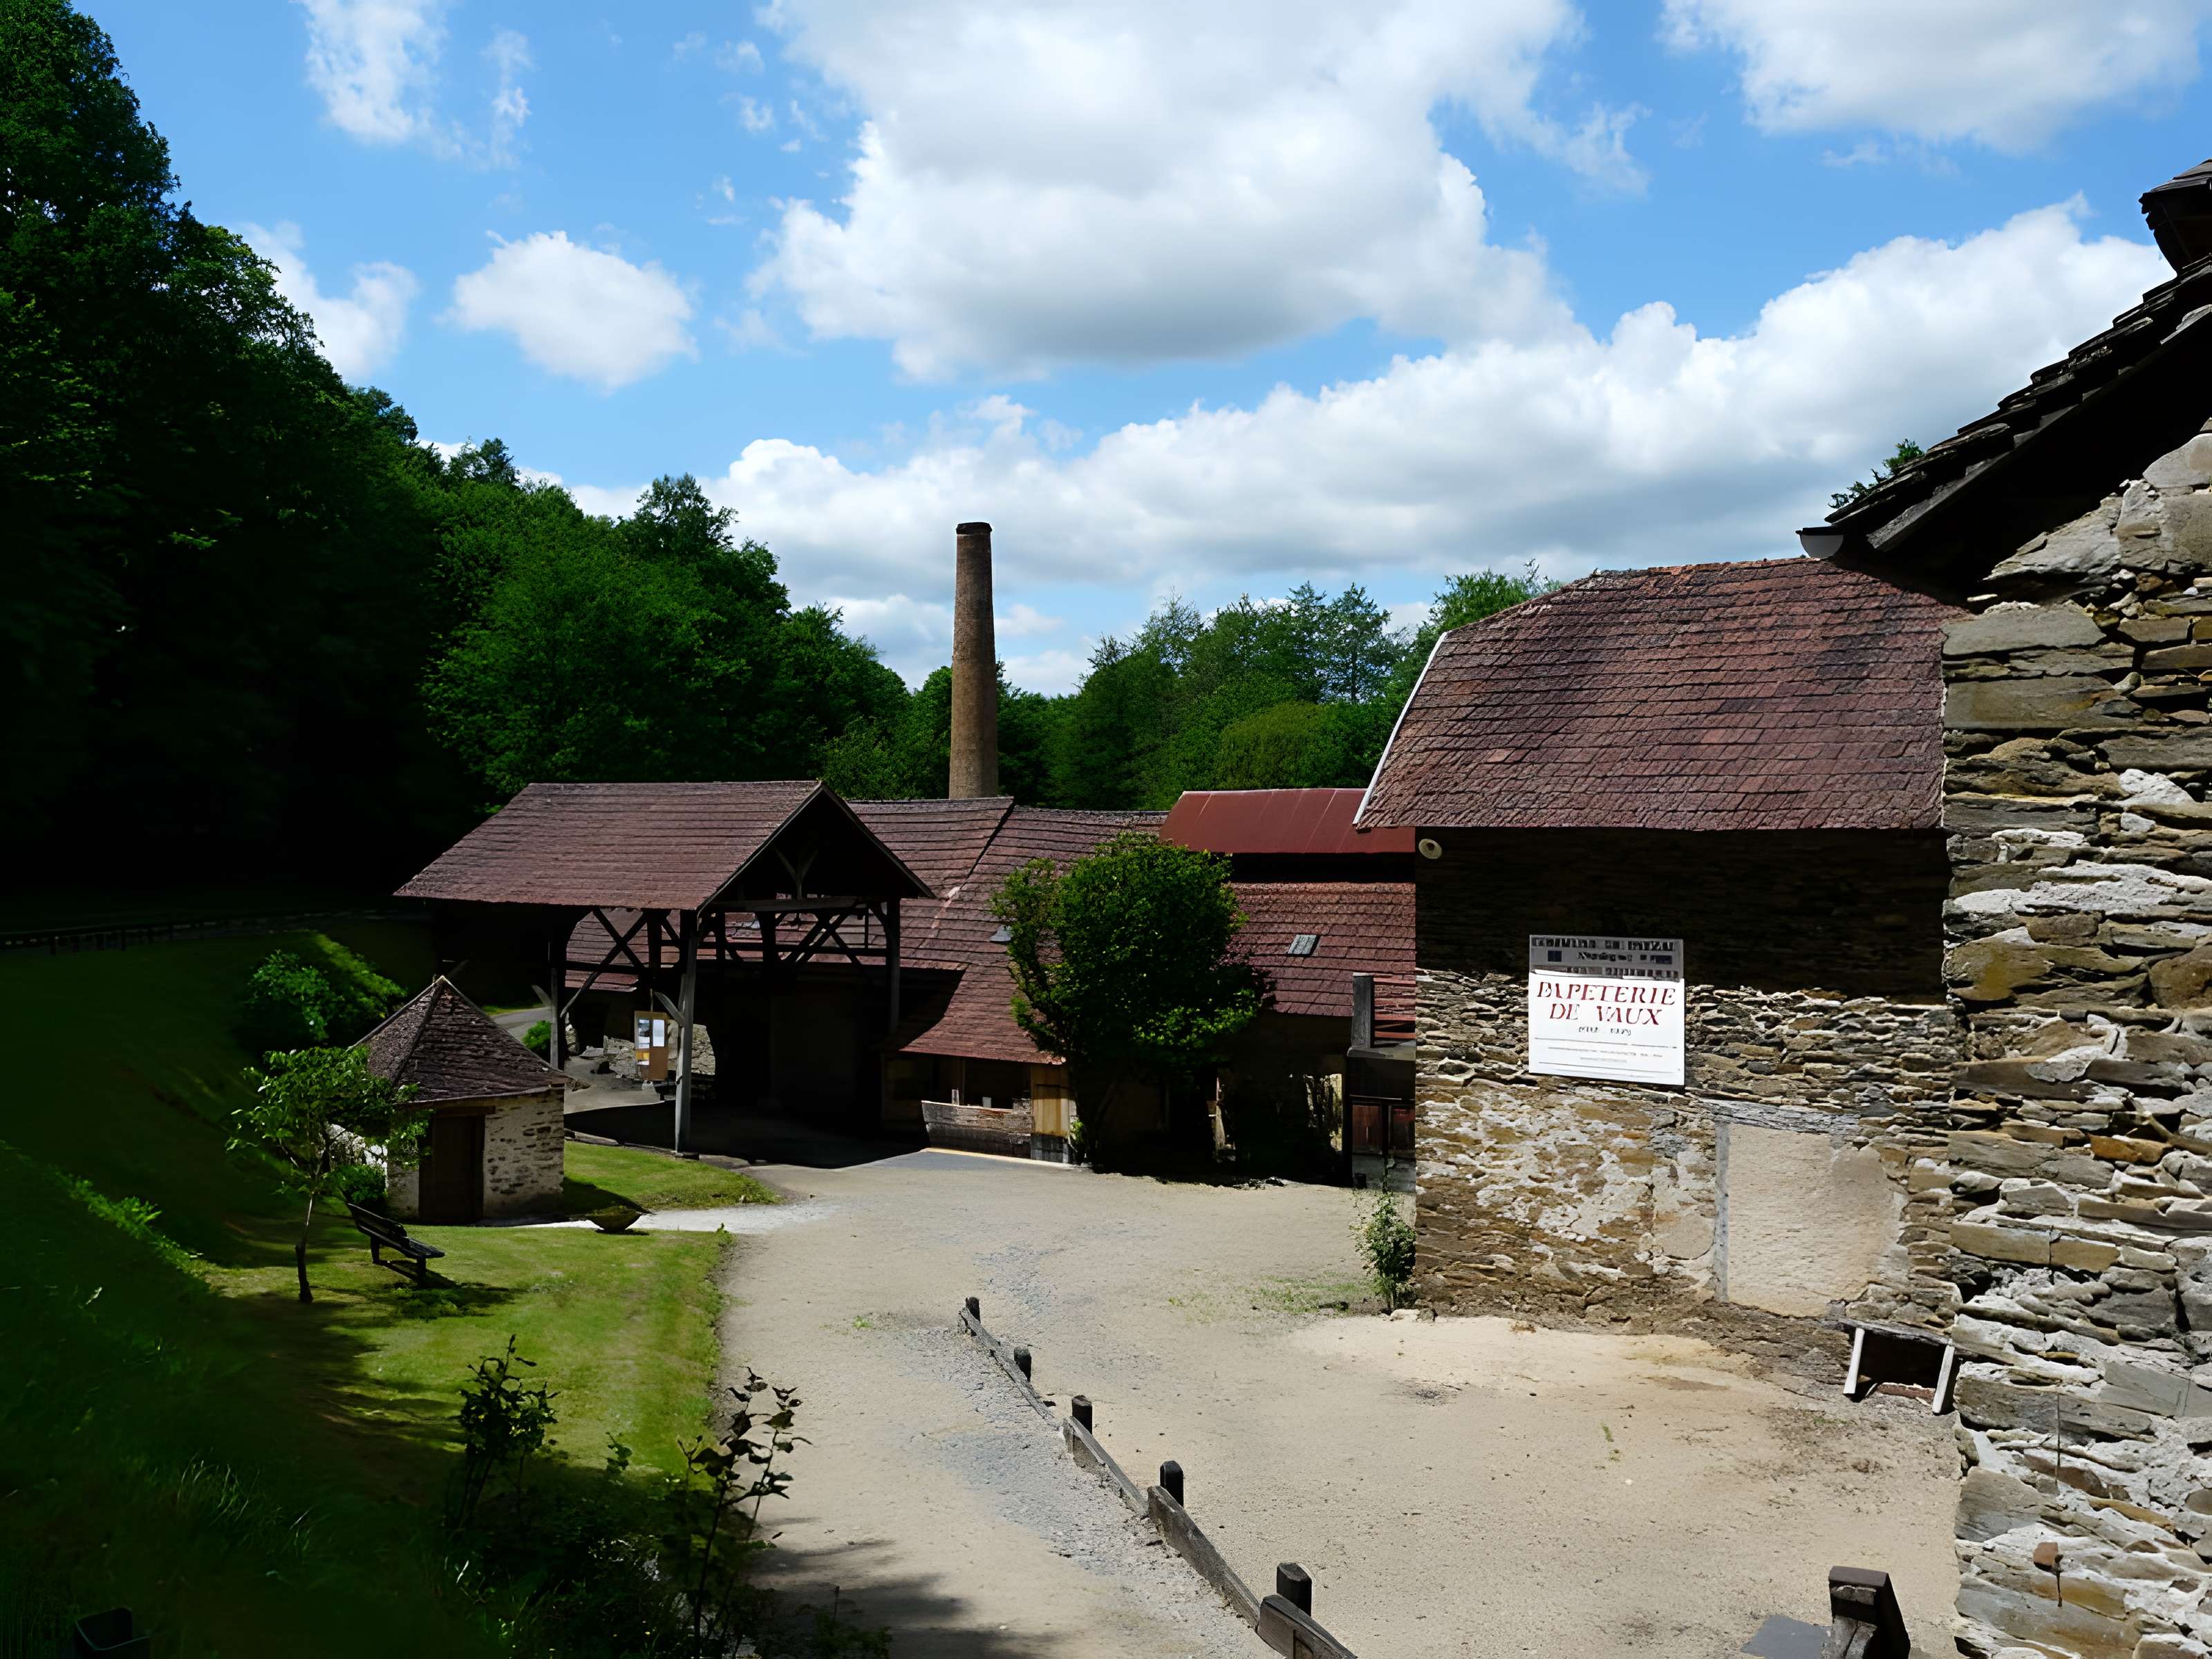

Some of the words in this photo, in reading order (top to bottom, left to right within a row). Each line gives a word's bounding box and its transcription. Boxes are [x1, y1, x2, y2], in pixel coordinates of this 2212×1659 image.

[1537, 982, 1676, 1005] PAPETERIE
[1550, 1003, 1580, 1020] DE
[1597, 1006, 1662, 1025] VAUX
